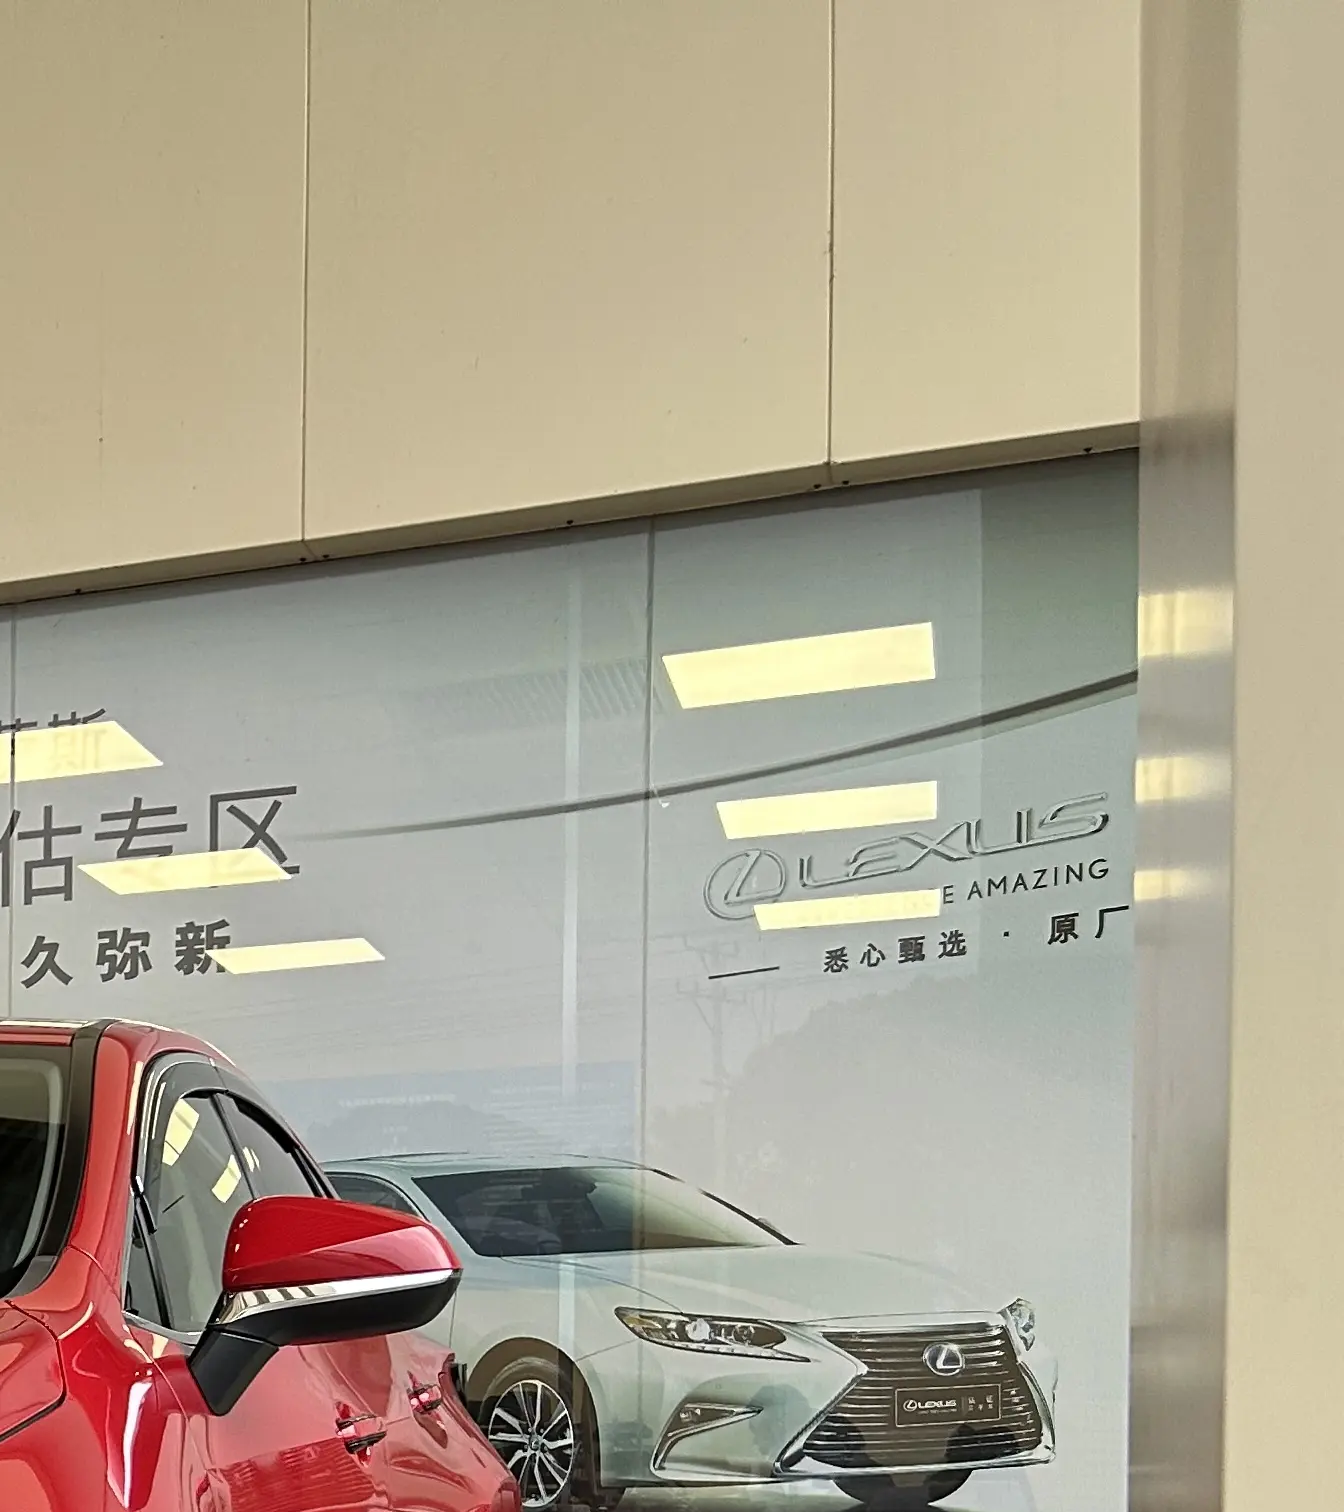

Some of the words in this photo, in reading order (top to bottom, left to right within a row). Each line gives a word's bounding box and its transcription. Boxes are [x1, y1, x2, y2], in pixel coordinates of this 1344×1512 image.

[798, 791, 1110, 889] LEXUS
[967, 858, 1110, 901] AMAZING
[822, 929, 968, 975] 悉心甄选
